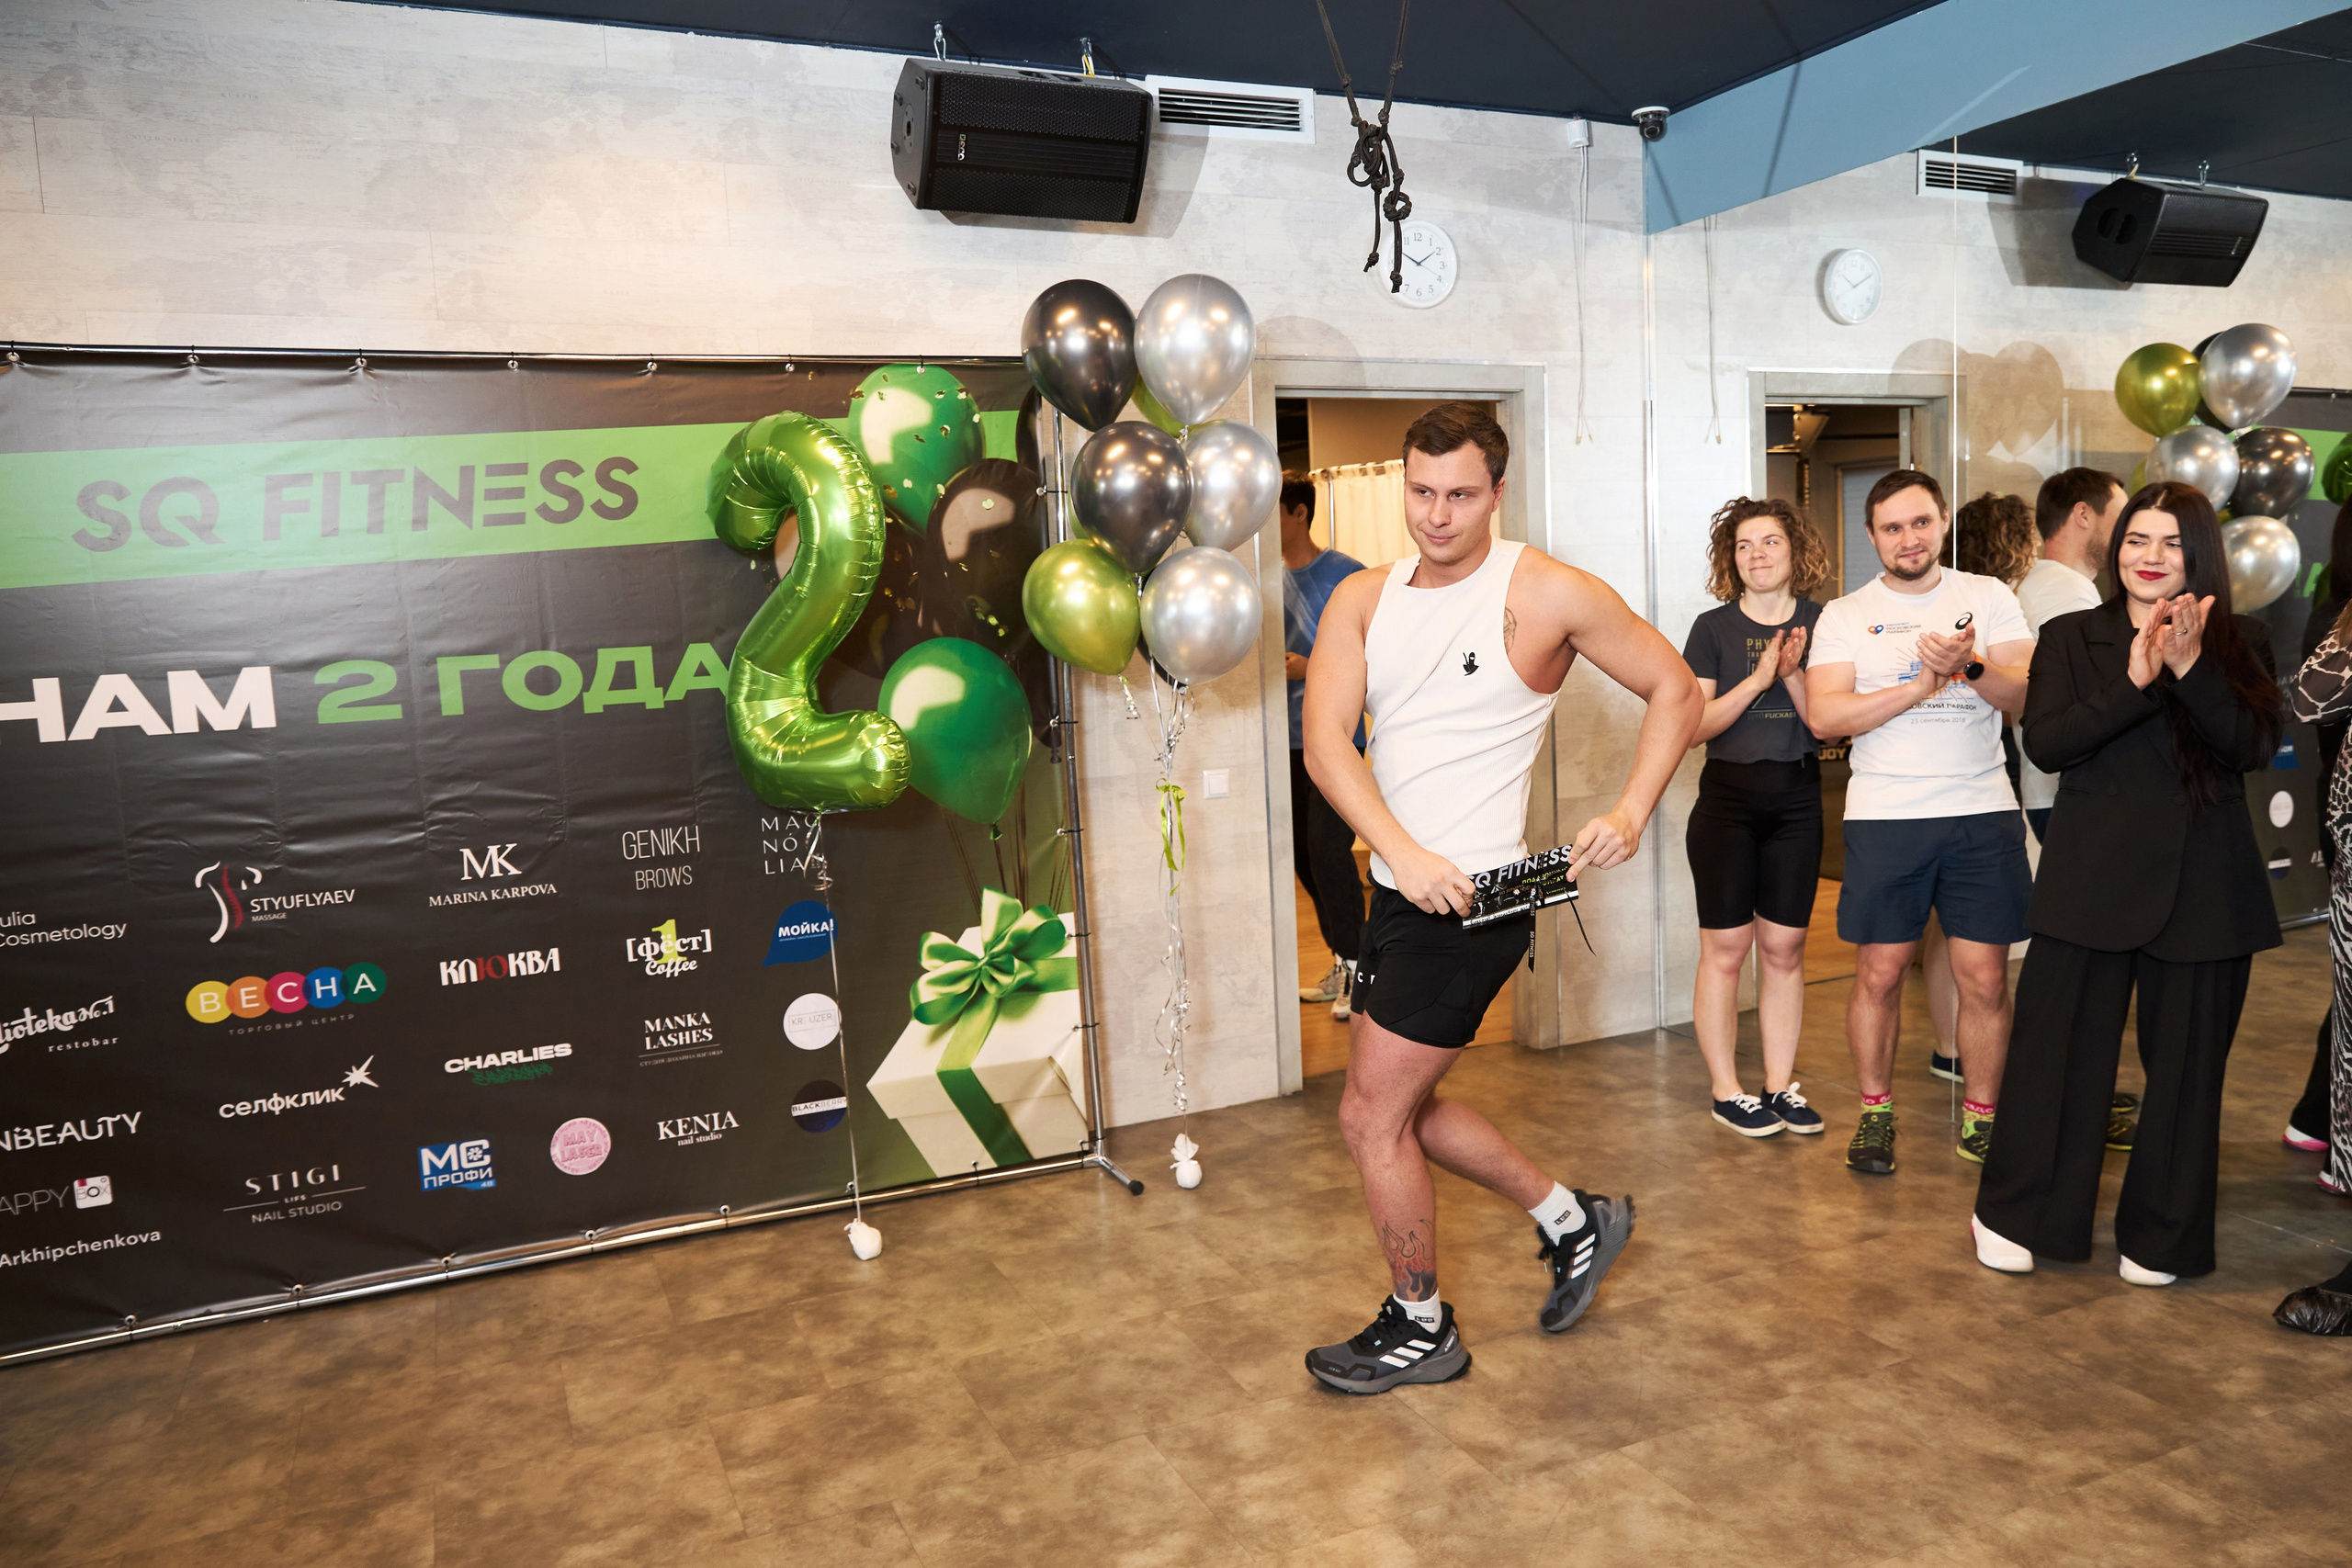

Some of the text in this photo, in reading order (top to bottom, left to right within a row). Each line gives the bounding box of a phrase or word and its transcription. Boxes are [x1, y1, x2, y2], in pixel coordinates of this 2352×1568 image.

[1403, 236, 1410, 245] 11
[1413, 232, 1422, 242] 12
[1435, 246, 1442, 255] 2
[1439, 261, 1445, 270] 3
[1404, 284, 1410, 293] 7
[1428, 284, 1434, 293] 5
[1436, 275, 1442, 283] 4
[1416, 288, 1422, 297] 6
[72, 456, 640, 552] SQ FITNESS
[0, 643, 731, 743] НАМ 2 ГОДА
[621, 825, 701, 860] GENIKH
[459, 842, 522, 881] MK
[764, 857, 805, 874] LIA
[1497, 844, 1572, 884] FITNESS
[635, 864, 693, 891] BROWS
[250, 889, 356, 914] STYUFLYAEV
[428, 884, 558, 908] MARINA KARPOVA
[252, 912, 288, 922] MASSAGE
[778, 919, 834, 938] МОЙКА!
[439, 947, 561, 987] КЛЮКВА
[645, 958, 698, 978] Coffee
[198, 972, 377, 1014] ВЕСНА
[228, 1014, 356, 1036] ТОРГОВЫЙ ЦЕНТР
[644, 1011, 711, 1034] MANKA
[48, 1037, 119, 1053] restobar
[645, 1028, 713, 1051] LASHES
[444, 1043, 573, 1074] CHARLIES
[219, 1087, 345, 1119] селфклик
[656, 1111, 741, 1141] KENIA
[562, 1129, 597, 1146] MAY
[677, 1132, 723, 1146] nail studio
[560, 1144, 603, 1163] LASER
[244, 1164, 340, 1195] STIGI
[424, 1167, 493, 1189] ПРОФИ
[251, 1201, 343, 1224] NAIL STUDIO
[0, 1231, 162, 1268] Arkhipchenkova
